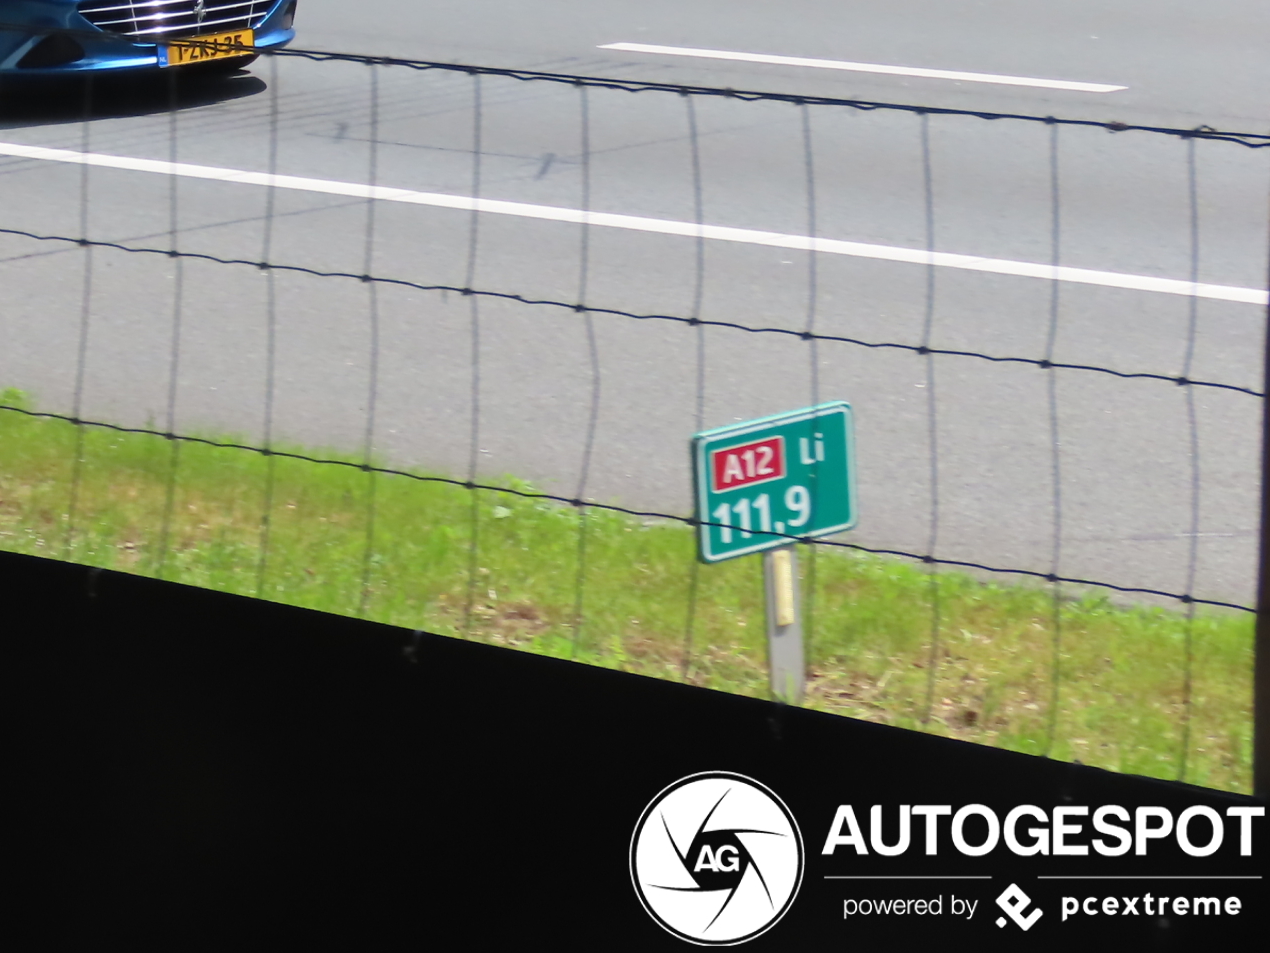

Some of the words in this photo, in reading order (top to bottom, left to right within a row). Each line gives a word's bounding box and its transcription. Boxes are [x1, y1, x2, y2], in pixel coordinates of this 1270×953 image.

[722, 446, 774, 483] A12
[799, 432, 825, 465] Li
[712, 485, 811, 543] 111.9
